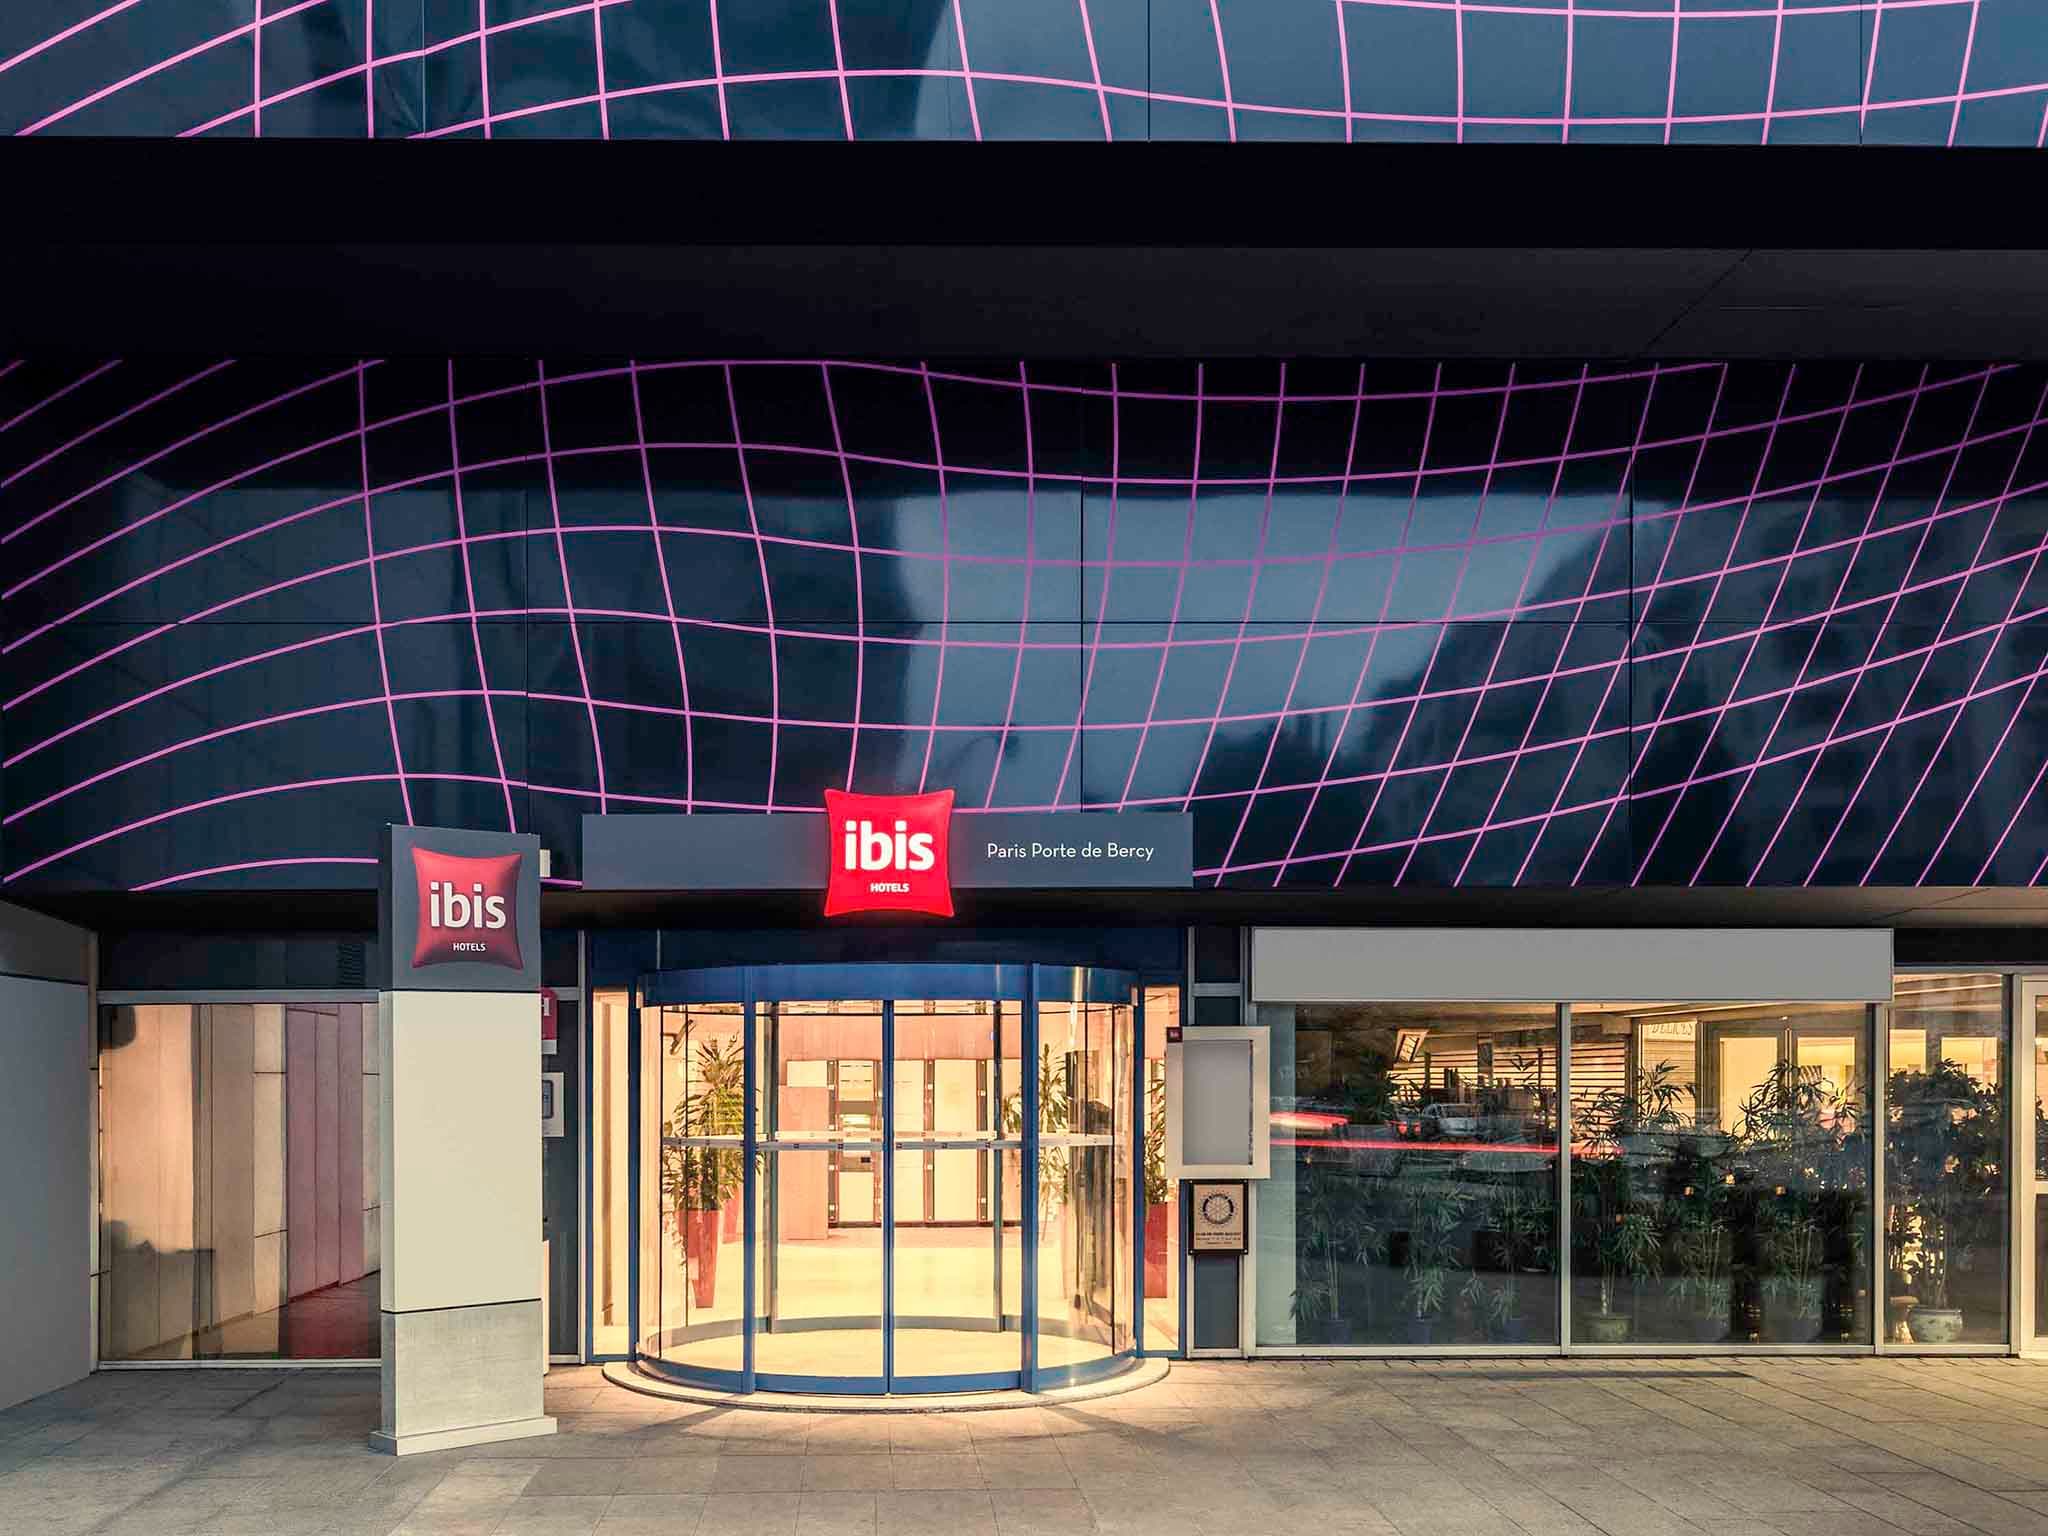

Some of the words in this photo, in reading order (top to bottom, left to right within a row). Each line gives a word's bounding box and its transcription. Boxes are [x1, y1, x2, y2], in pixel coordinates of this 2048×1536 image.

[844, 820, 935, 871] ibis
[987, 842, 1027, 858] Paris
[1032, 842, 1077, 858] Porte
[1081, 841, 1102, 858] de
[1107, 842, 1154, 862] Bercy
[870, 882, 910, 893] HOTELS
[430, 881, 507, 929] ibis
[452, 942, 486, 952] HOTELS
